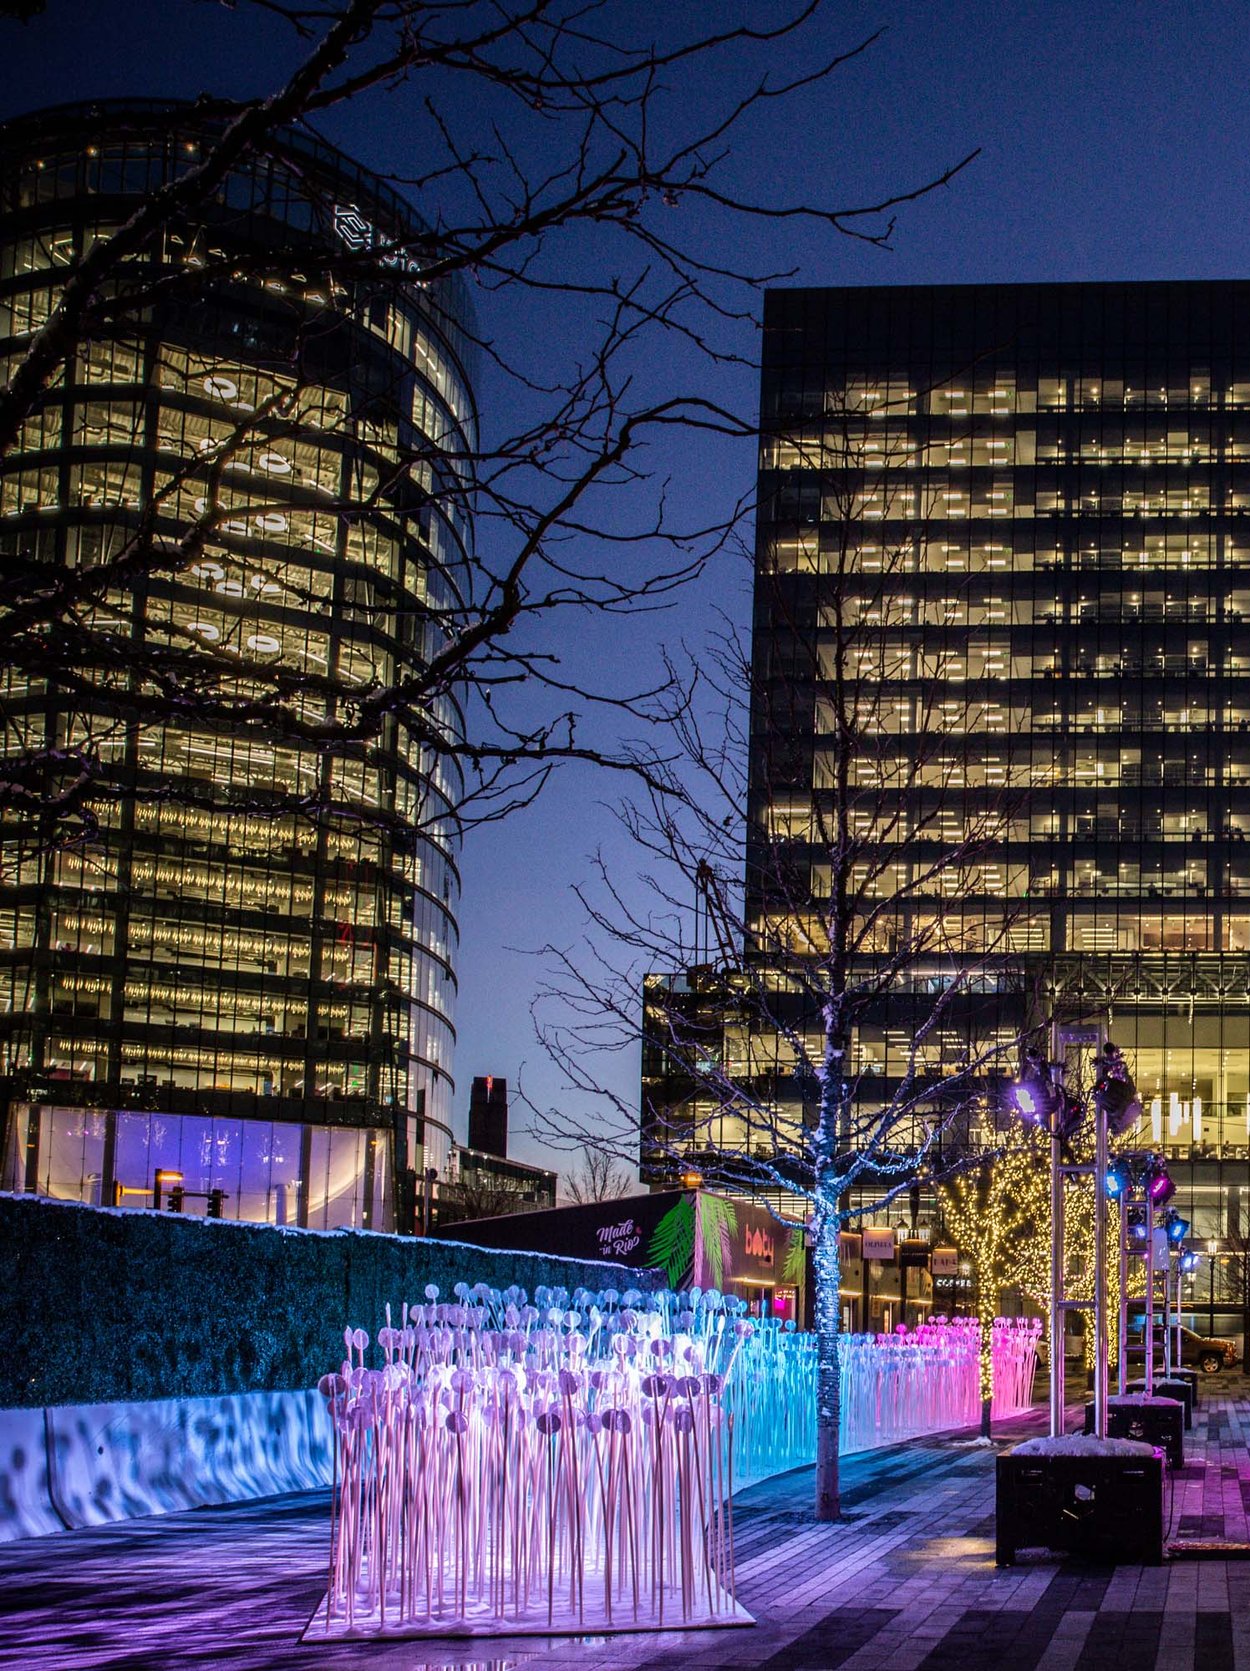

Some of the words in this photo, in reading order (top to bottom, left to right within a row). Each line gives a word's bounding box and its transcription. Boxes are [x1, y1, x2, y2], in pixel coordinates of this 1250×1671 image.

[596, 1219, 634, 1242] Made
[599, 1244, 611, 1255] in
[612, 1236, 640, 1255] Rio
